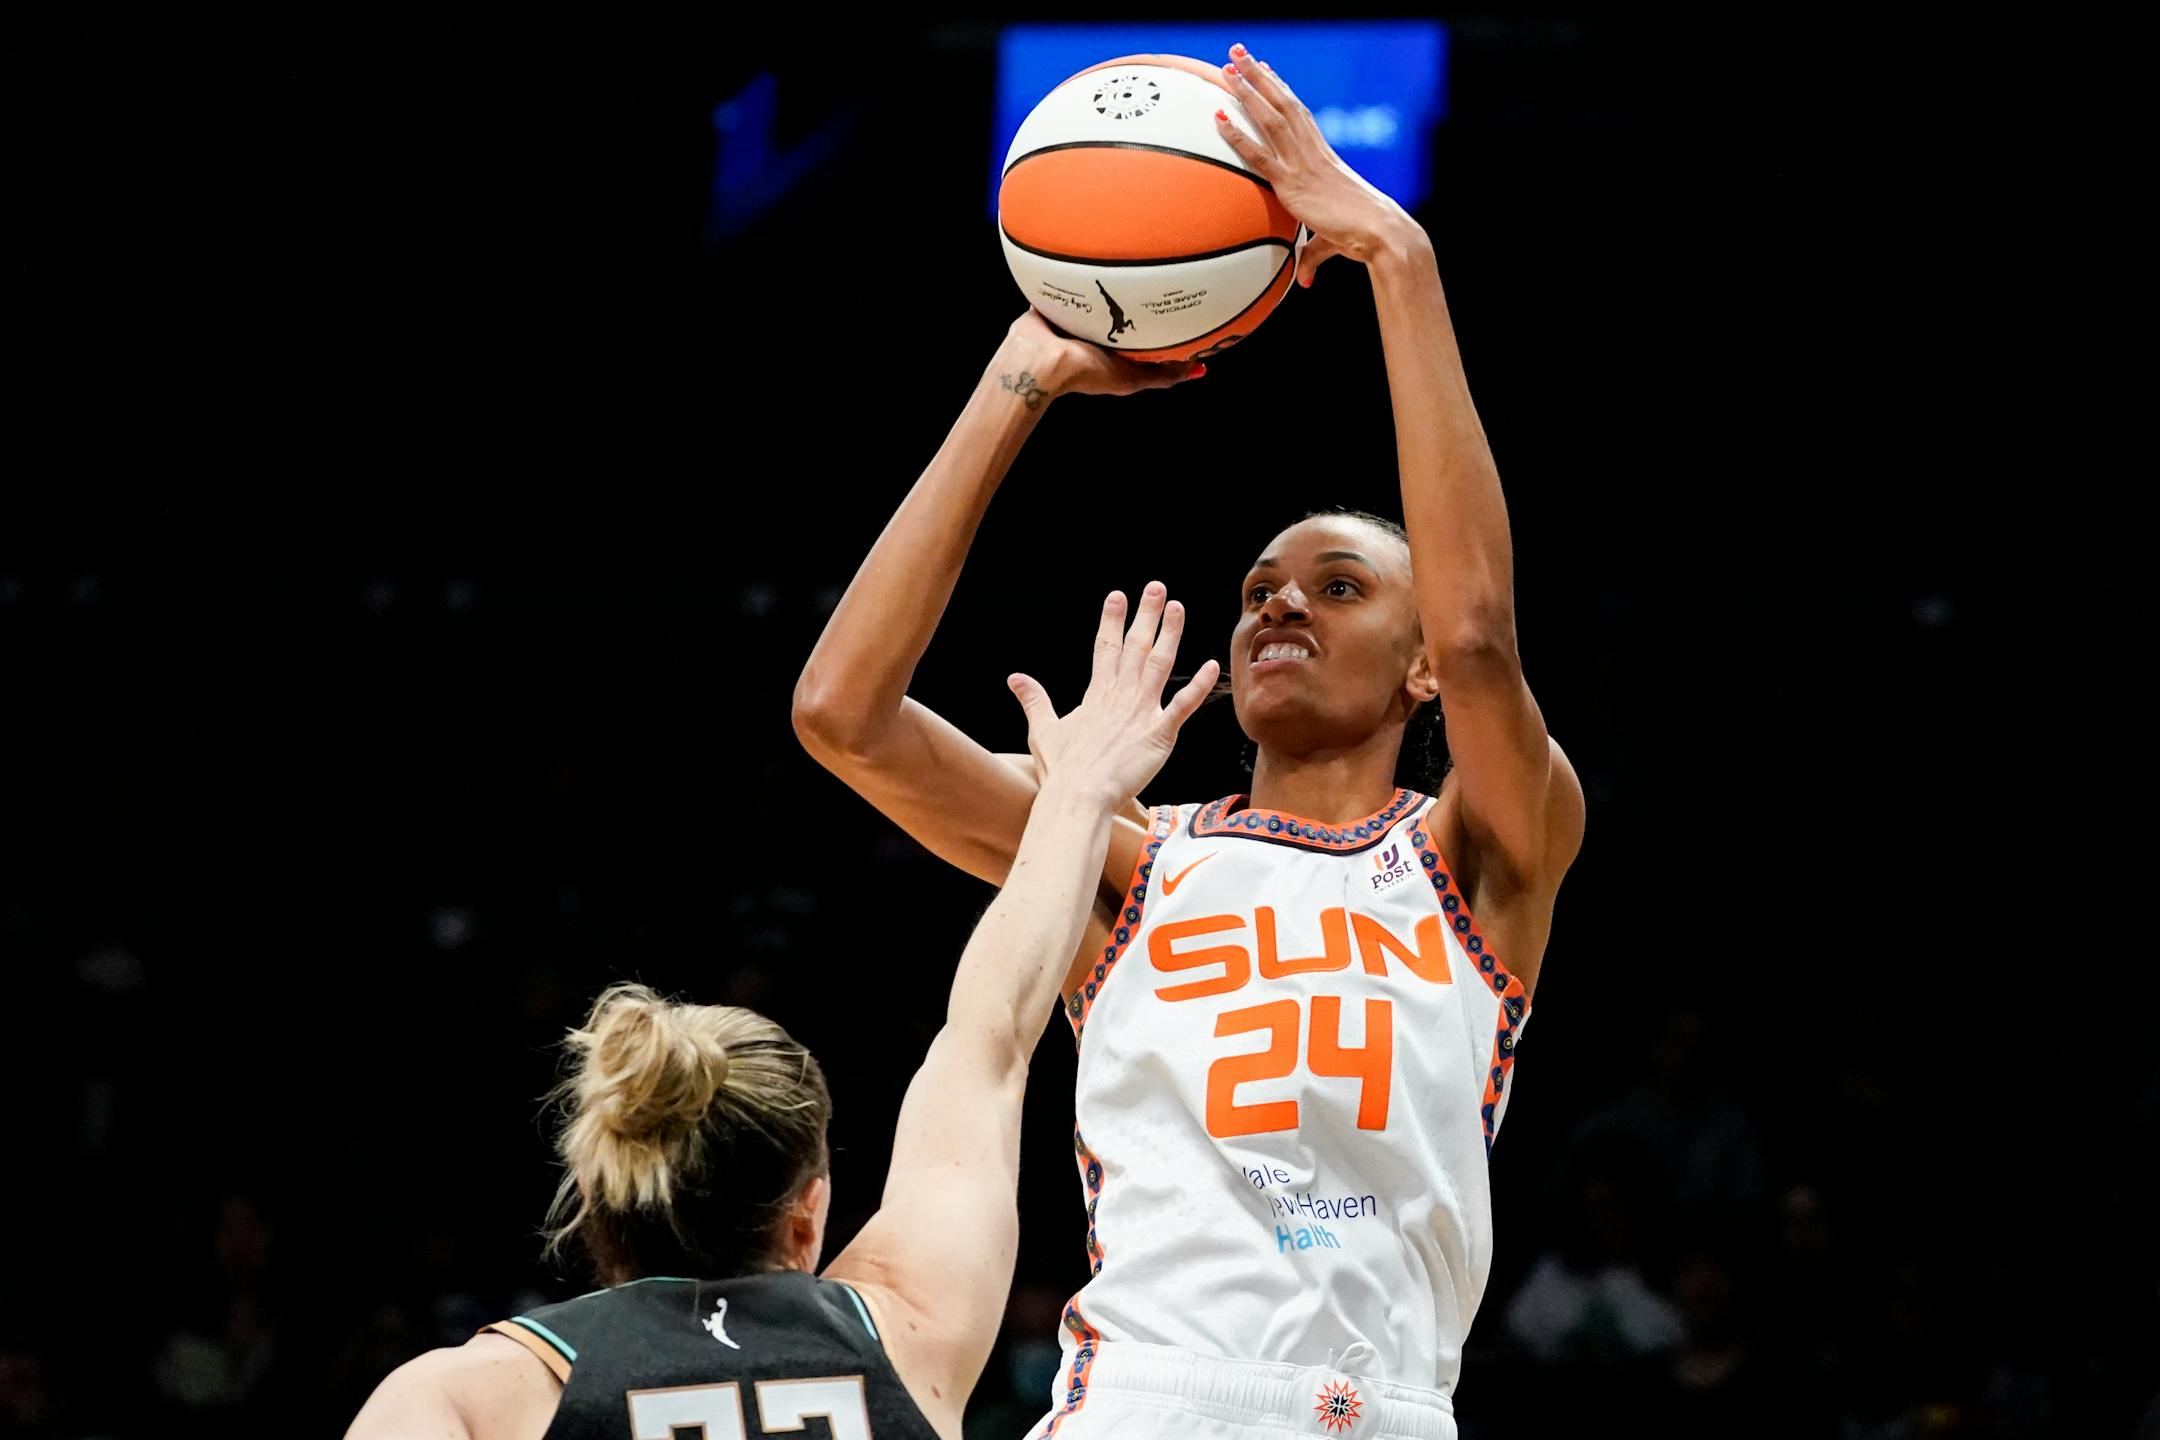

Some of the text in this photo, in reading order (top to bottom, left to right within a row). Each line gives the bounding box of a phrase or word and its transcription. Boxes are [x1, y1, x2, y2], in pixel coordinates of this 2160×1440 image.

[1371, 860, 1413, 889] Post
[1148, 905, 1453, 1003] SUN
[1205, 995, 1393, 1139] 24
[1243, 1163, 1290, 1190] ale
